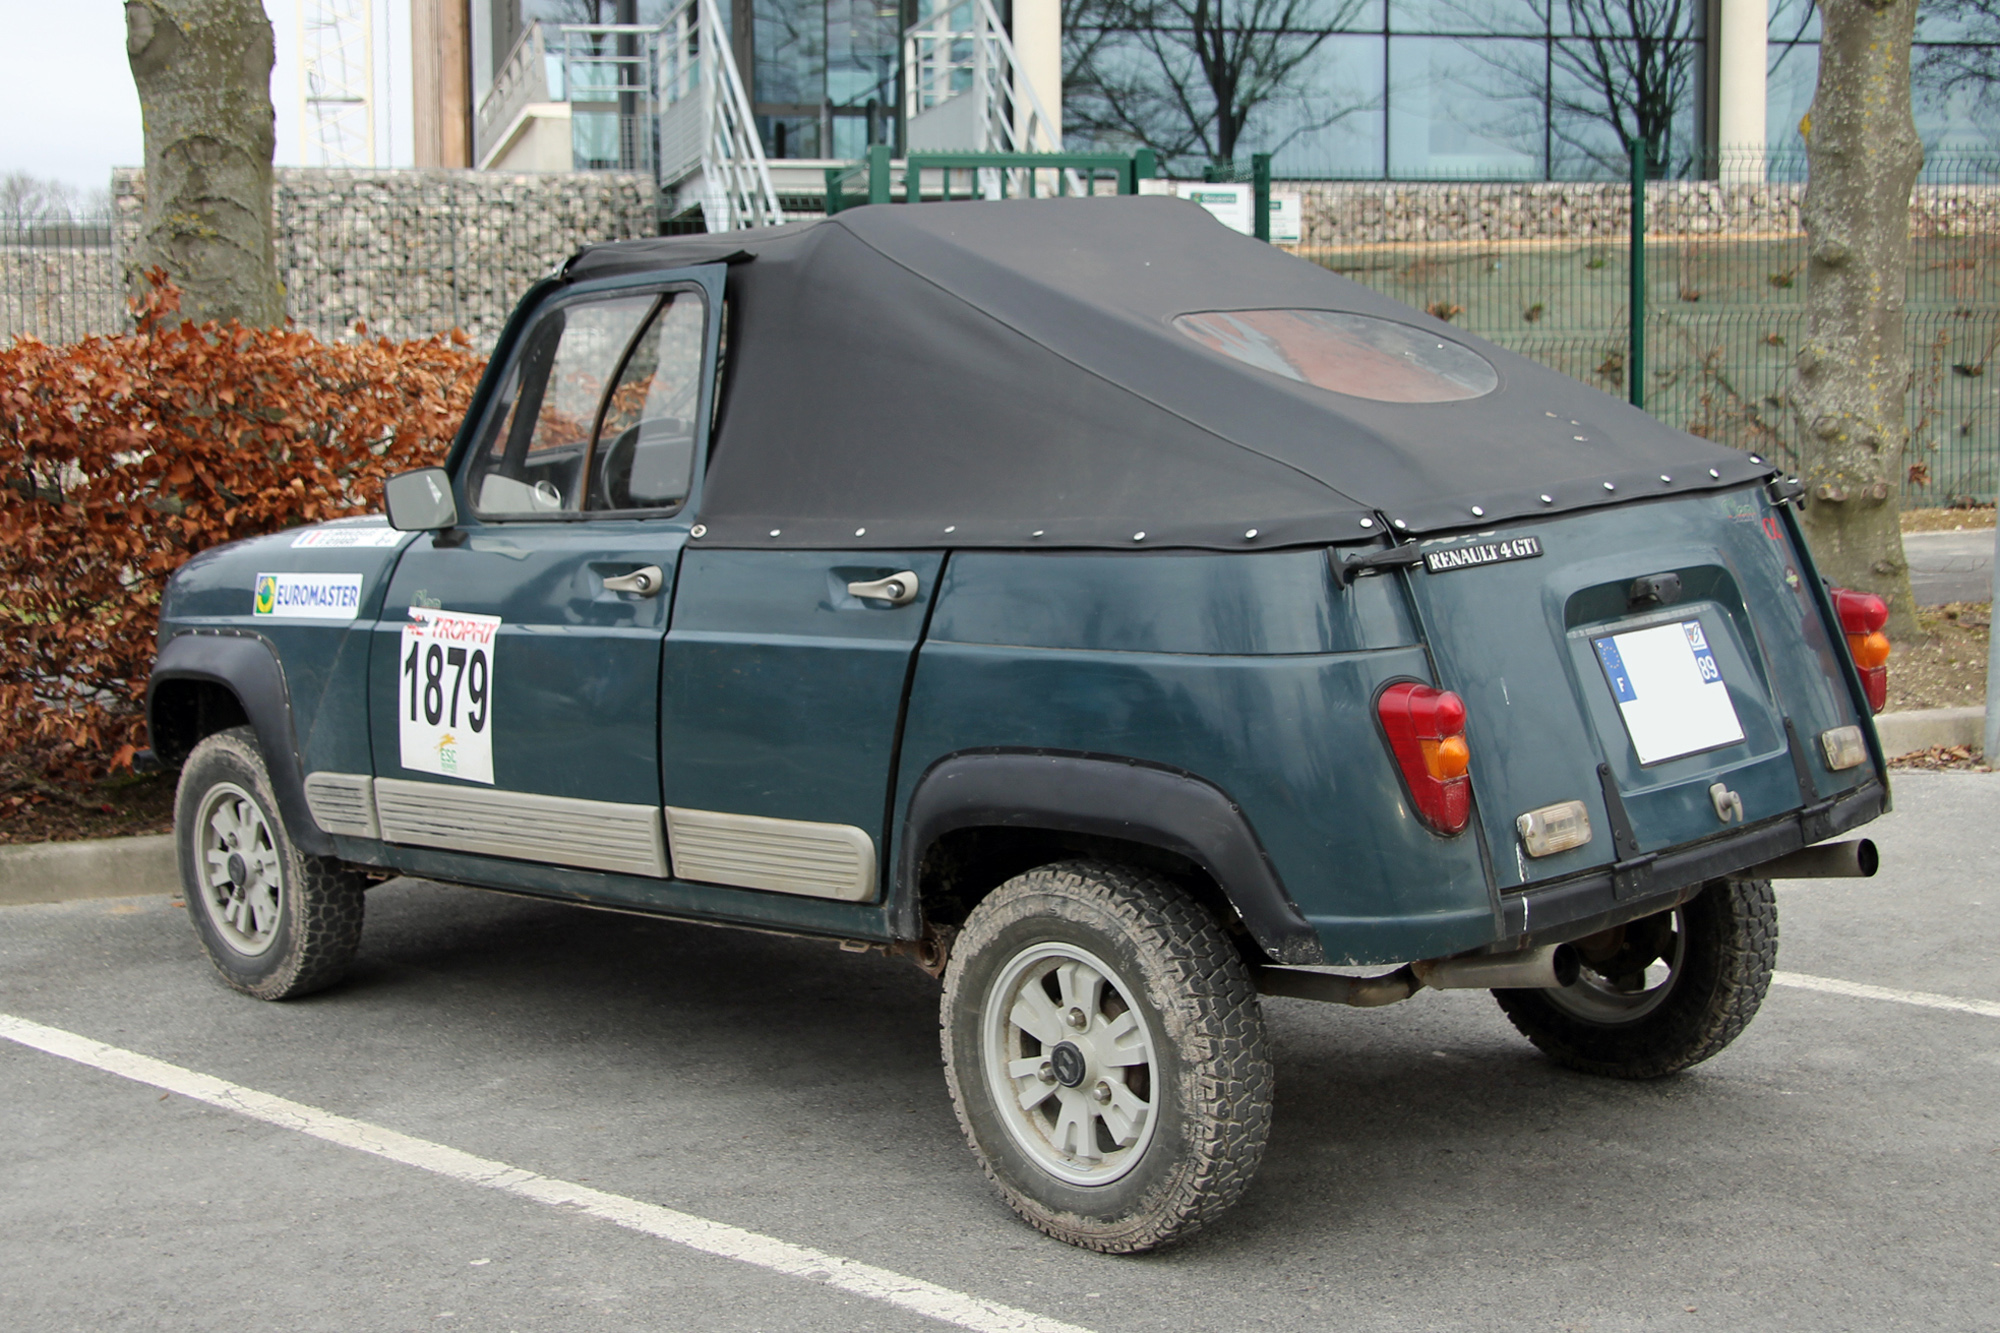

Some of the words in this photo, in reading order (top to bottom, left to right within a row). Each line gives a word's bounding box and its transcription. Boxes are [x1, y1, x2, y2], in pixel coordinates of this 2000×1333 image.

[1429, 545, 1498, 569] RENAULT
[1500, 542, 1512, 558] 4
[276, 585, 358, 607] EUROMASTER
[432, 616, 498, 645] TROPHY
[1697, 655, 1719, 681] 89
[404, 640, 488, 733] 1879
[1616, 676, 1625, 693] F
